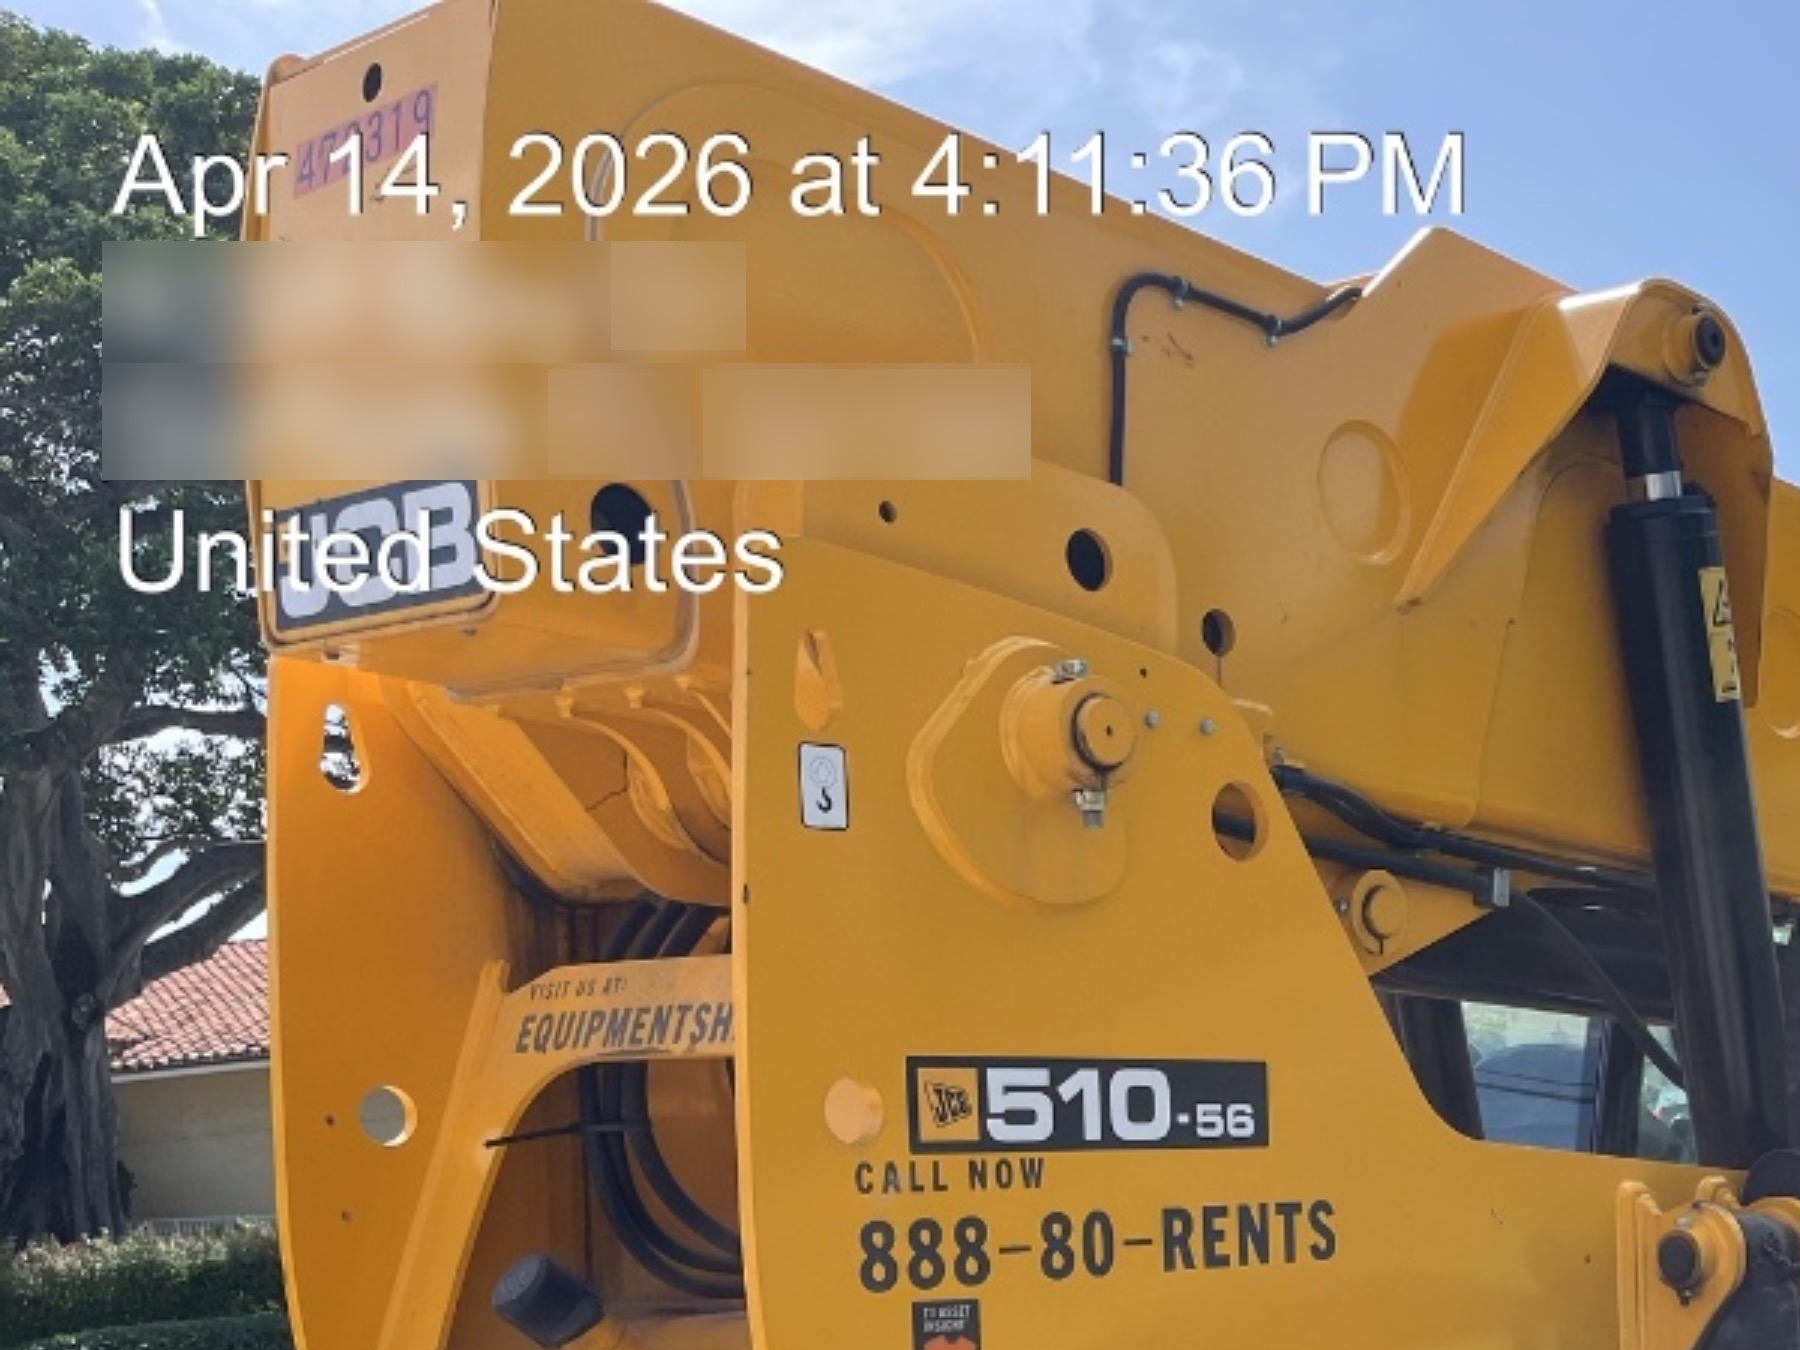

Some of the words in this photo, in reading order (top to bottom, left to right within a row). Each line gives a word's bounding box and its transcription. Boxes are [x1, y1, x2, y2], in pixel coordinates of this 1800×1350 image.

[278, 482, 477, 618] JCB
[515, 1001, 736, 1054] EQUIPMENTSH
[854, 1160, 949, 1194] CALL
[968, 1157, 1045, 1189] NOW
[859, 1200, 1337, 1294] 888-80-RENTS
